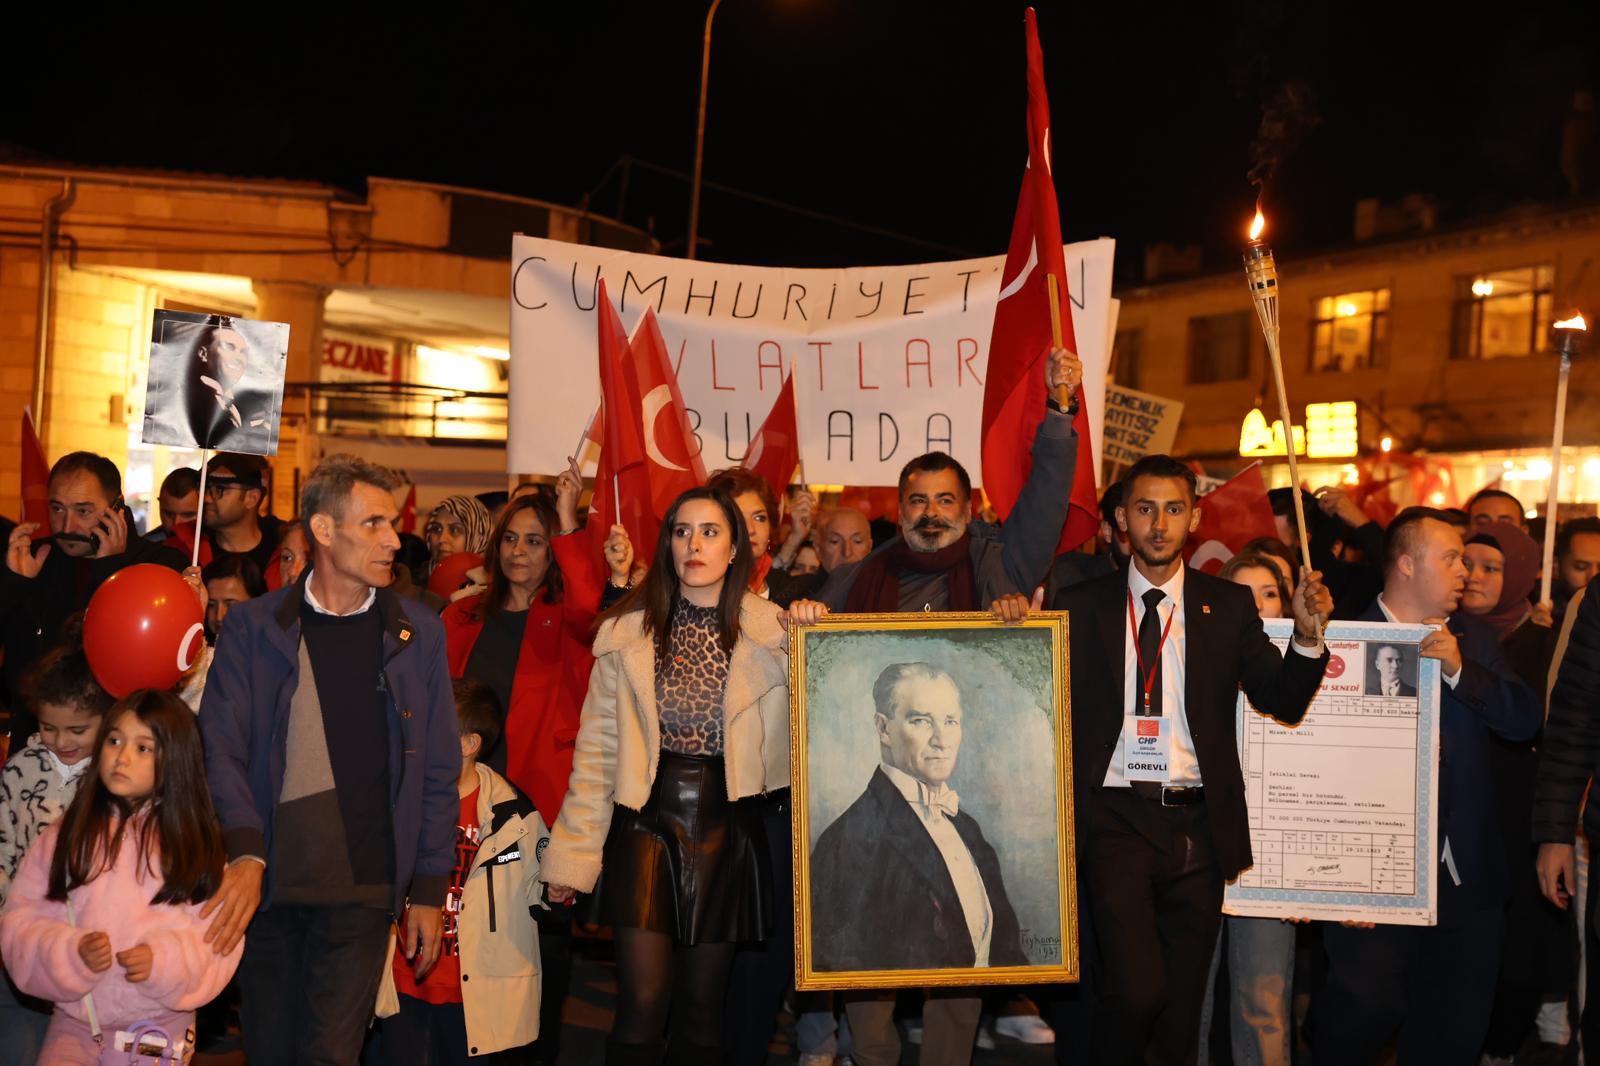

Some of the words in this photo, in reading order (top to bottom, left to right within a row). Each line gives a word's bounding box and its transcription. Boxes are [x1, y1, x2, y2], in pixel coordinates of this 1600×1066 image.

[1104, 408, 1159, 435] AYITSIZ
[1138, 737, 1157, 745] CHP
[1127, 762, 1167, 771] GÖREVLİ
